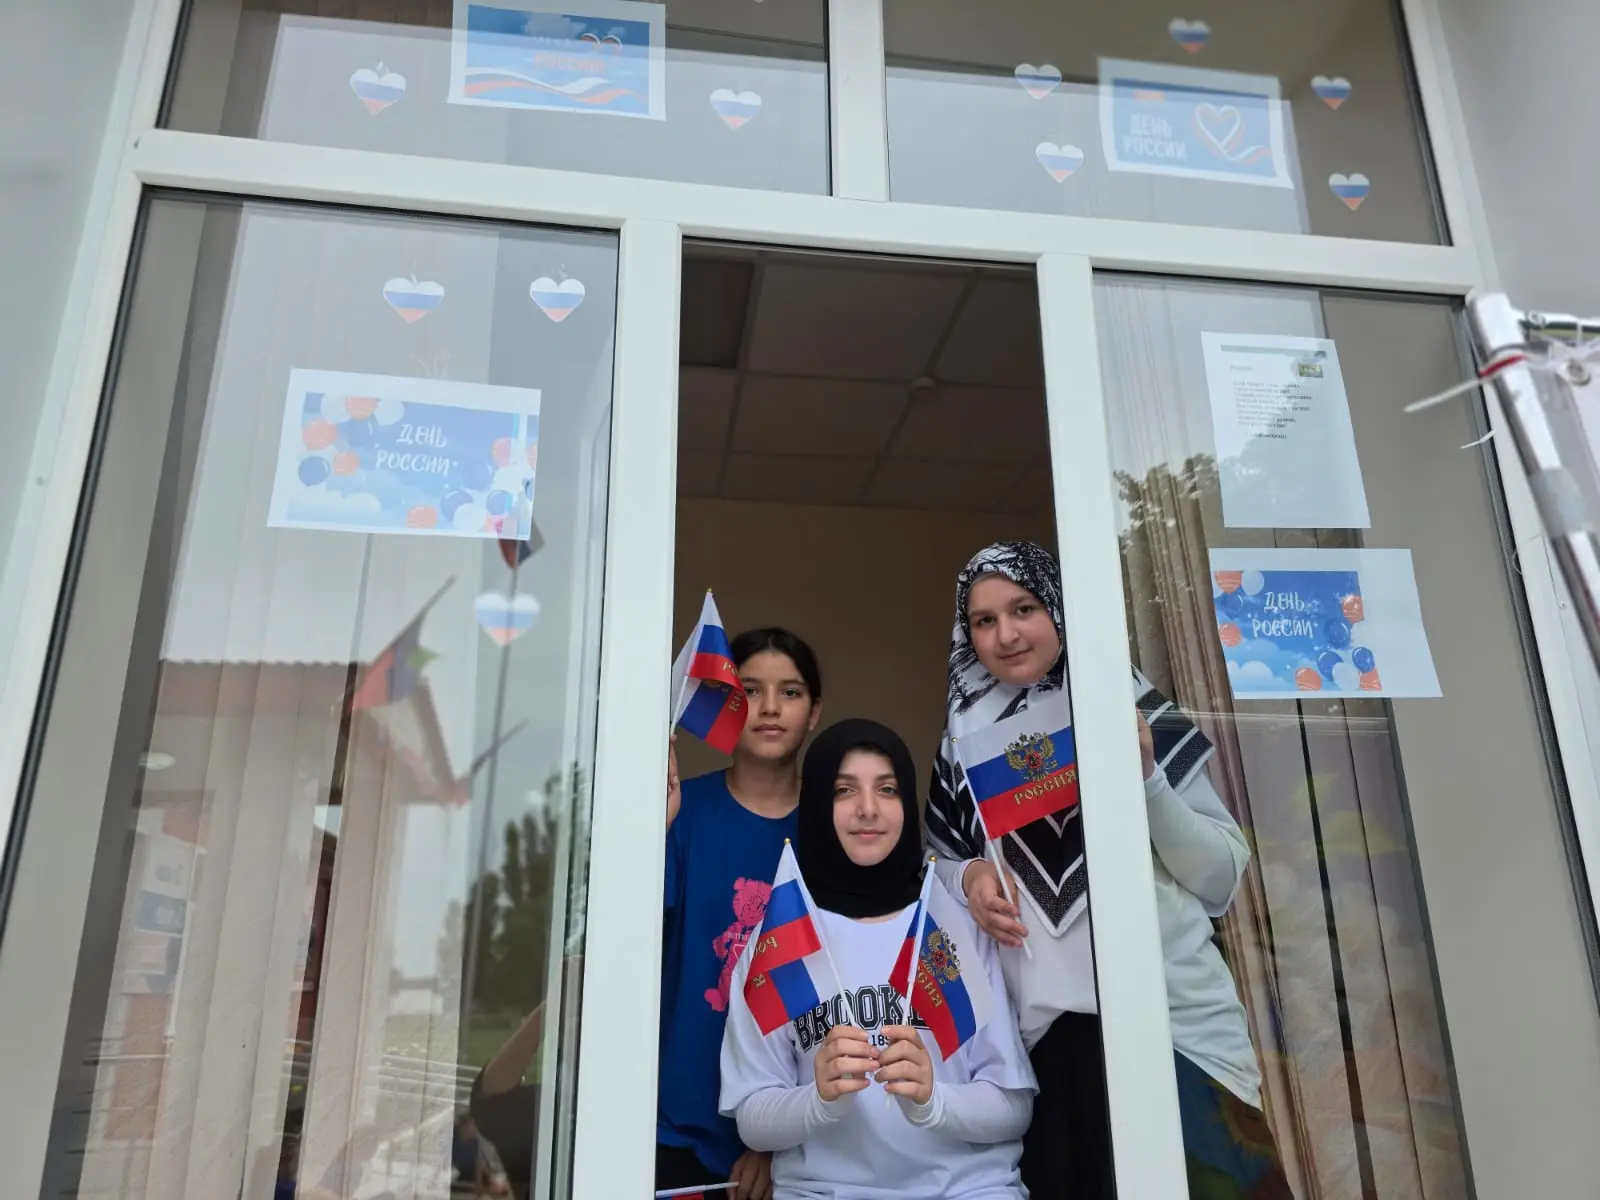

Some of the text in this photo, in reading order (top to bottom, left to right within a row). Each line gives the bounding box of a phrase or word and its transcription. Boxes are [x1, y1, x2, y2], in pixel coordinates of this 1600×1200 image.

[1130, 113, 1173, 138] ДЕНЬ
[1122, 134, 1187, 162] РОССИИ
[396, 423, 447, 448] ДЕНЬ
[376, 449, 450, 477] РОССИИ
[1263, 591, 1305, 614] ДЕНЬ
[1252, 618, 1314, 639] РОССИИ
[1014, 769, 1078, 805] РОССИЯ
